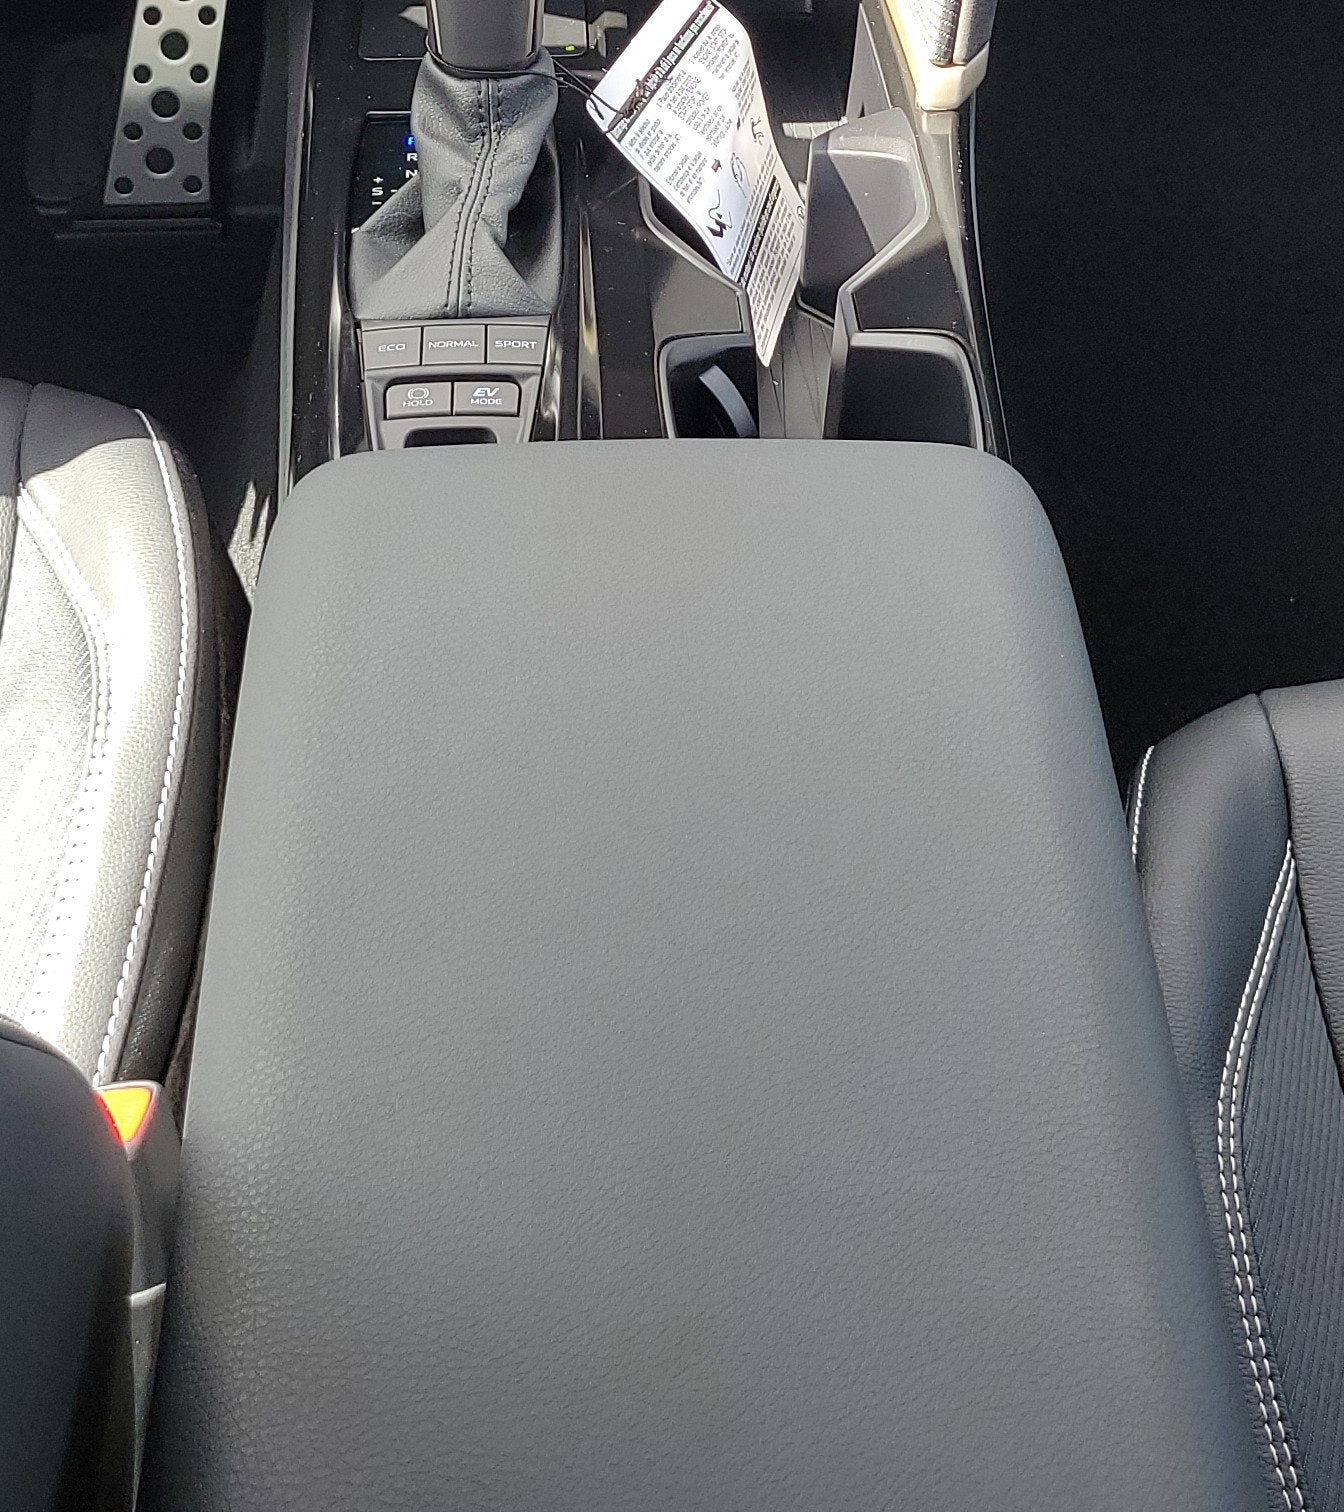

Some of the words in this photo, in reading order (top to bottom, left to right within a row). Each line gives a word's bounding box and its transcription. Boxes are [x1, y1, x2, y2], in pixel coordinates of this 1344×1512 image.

[406, 153, 418, 161] R
[378, 343, 406, 352] ECO
[428, 340, 479, 349] NORMAL
[495, 340, 538, 350] SPORT
[472, 387, 500, 397] EV
[402, 399, 433, 407] HOLD
